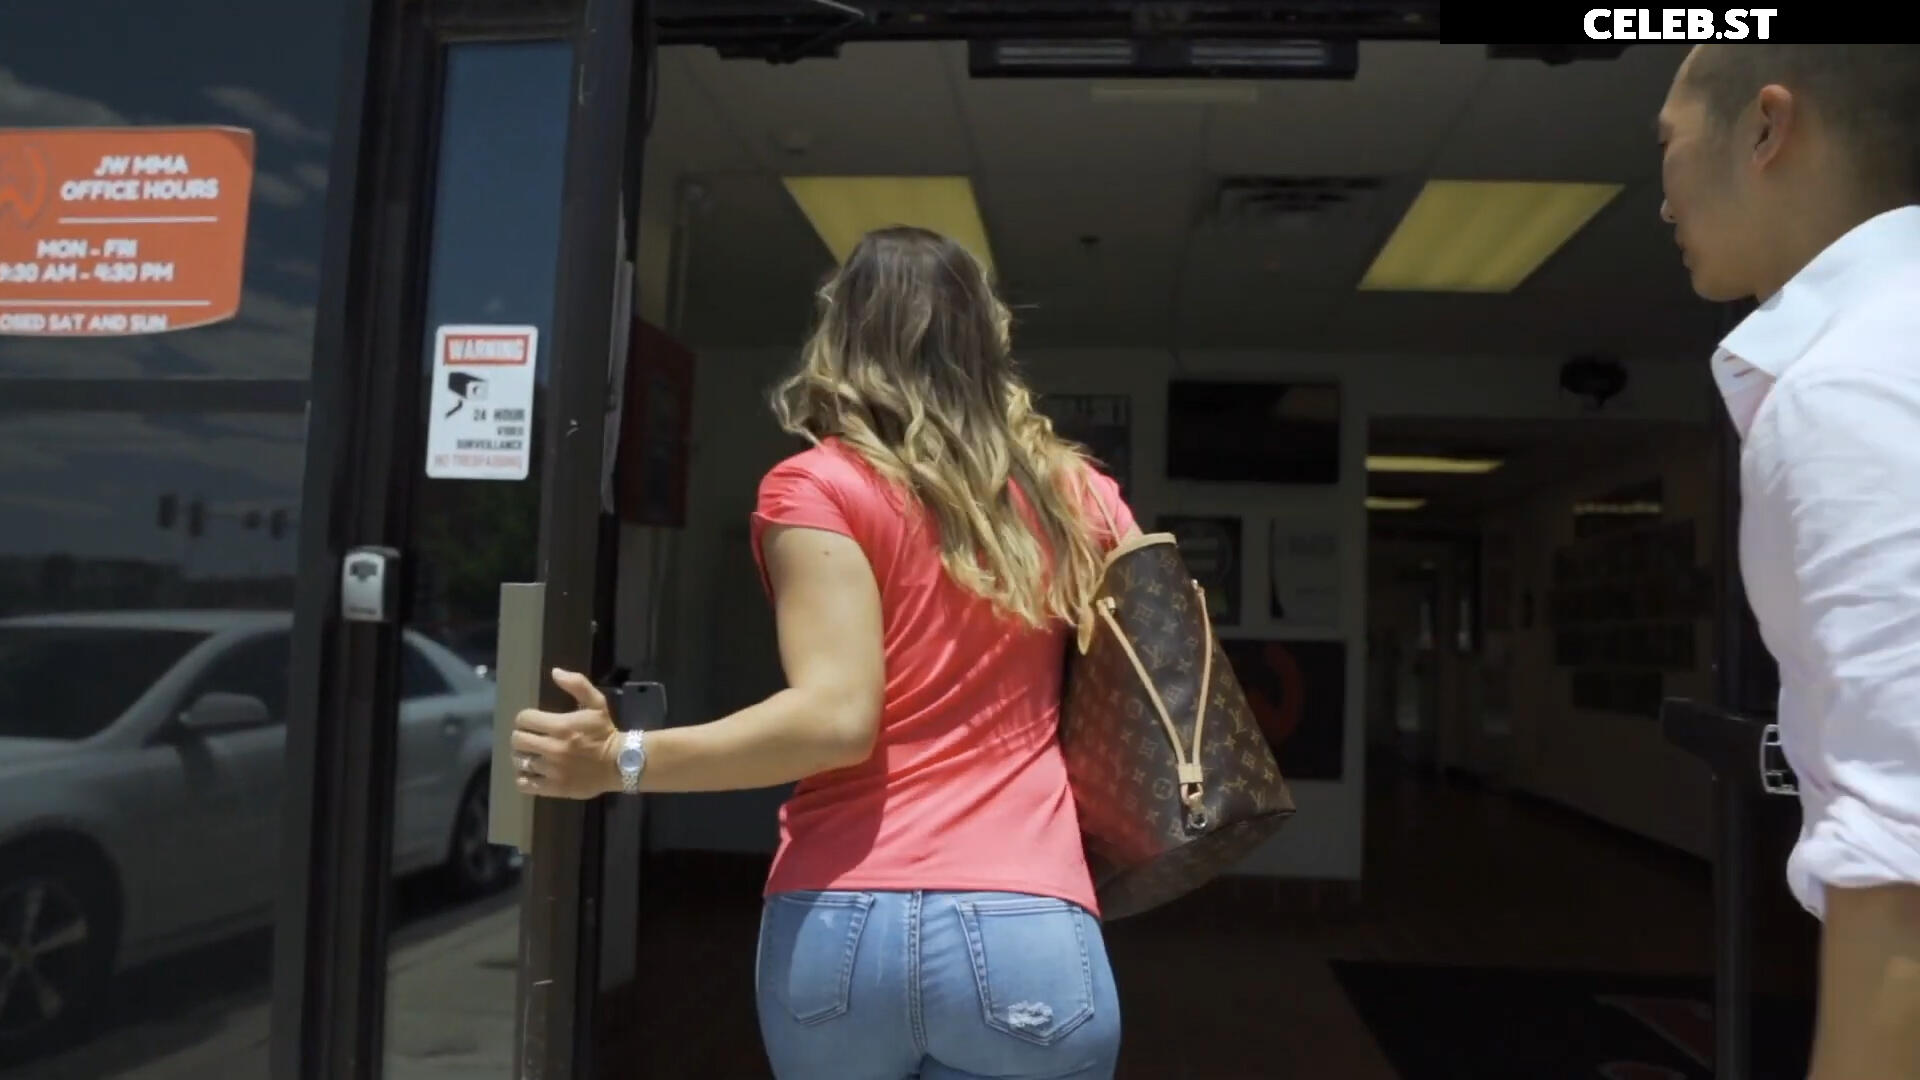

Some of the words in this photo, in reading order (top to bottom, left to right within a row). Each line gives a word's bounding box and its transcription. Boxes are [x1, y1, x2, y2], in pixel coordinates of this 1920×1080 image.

[95, 155, 129, 176] JW
[132, 155, 188, 175] MMA
[60, 179, 140, 201] OFFICE
[143, 178, 219, 199] HOURS
[36, 239, 88, 259] MON
[103, 238, 138, 258] FRI
[41, 262, 77, 282] AM
[140, 262, 175, 281] PM
[49, 313, 85, 331] SAT
[88, 313, 127, 331] AND
[130, 313, 168, 331] SUN
[449, 337, 526, 361] WARNING
[473, 409, 487, 421] 24
[494, 408, 525, 422] HOUR
[456, 439, 523, 450] SURVEILLANCE
